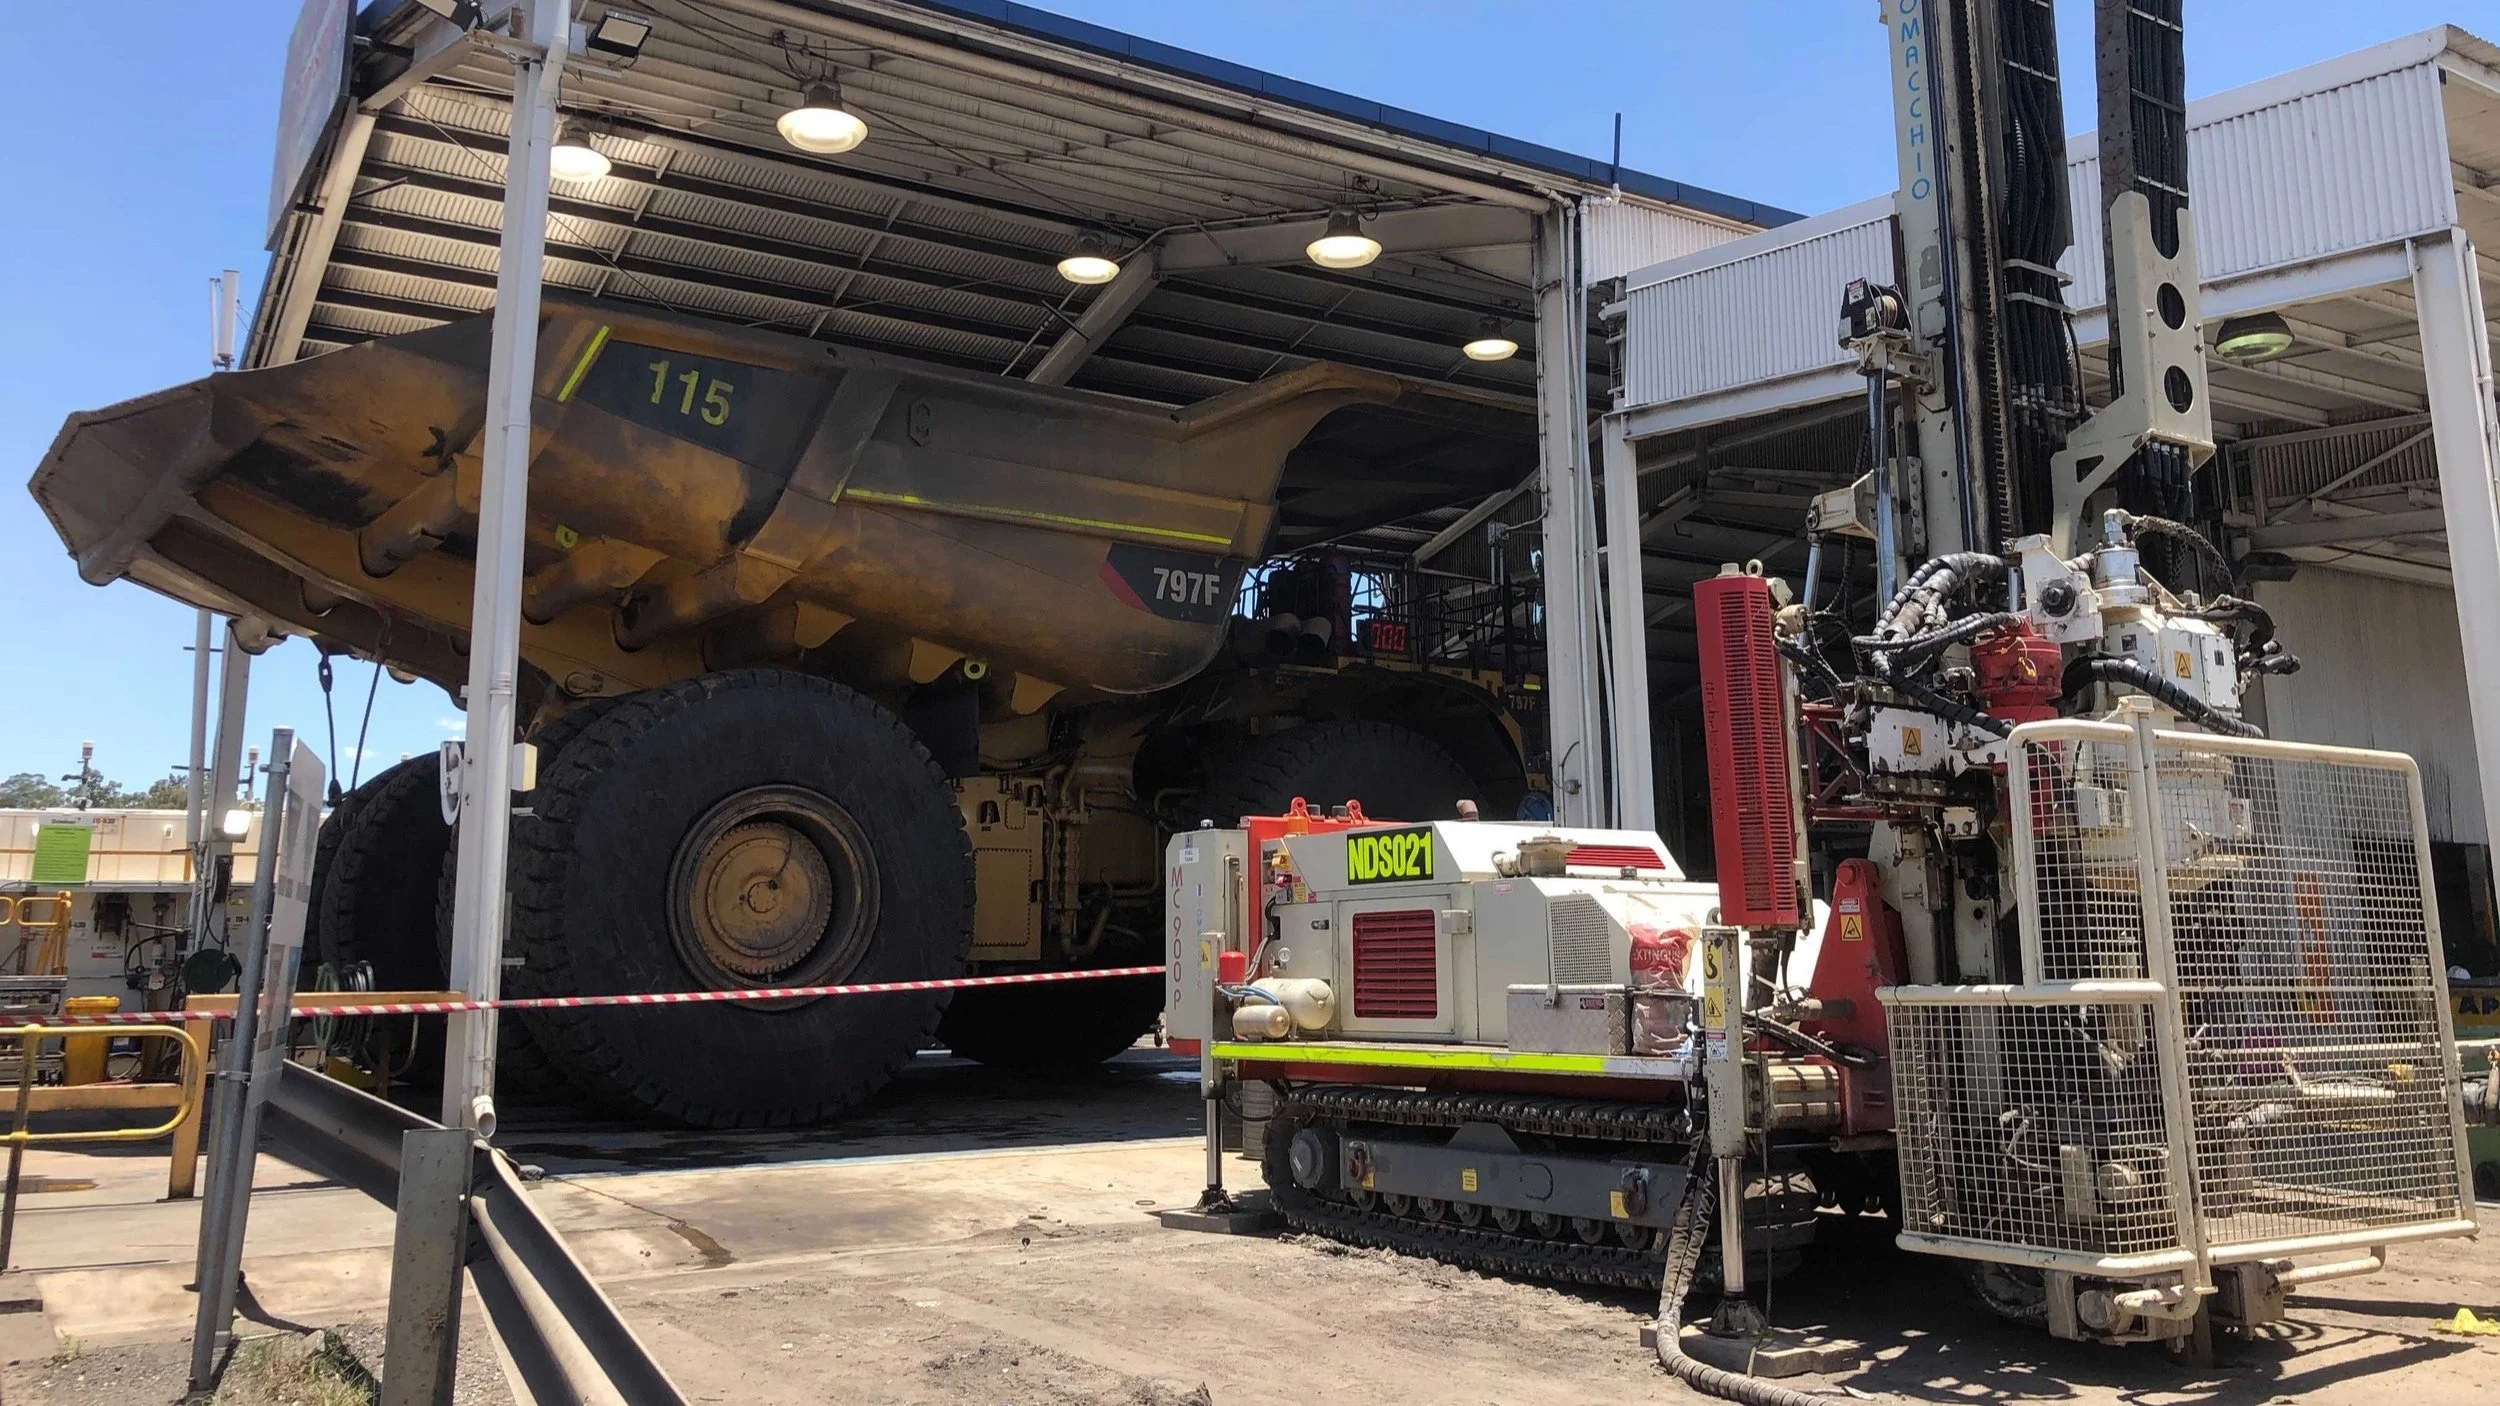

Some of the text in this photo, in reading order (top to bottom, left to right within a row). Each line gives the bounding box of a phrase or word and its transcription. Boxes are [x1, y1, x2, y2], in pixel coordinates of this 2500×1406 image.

[649, 360, 734, 426] 115
[1153, 566, 1220, 606] 797F
[1508, 694, 1536, 711] 797F
[1348, 831, 1432, 880] NDS021
